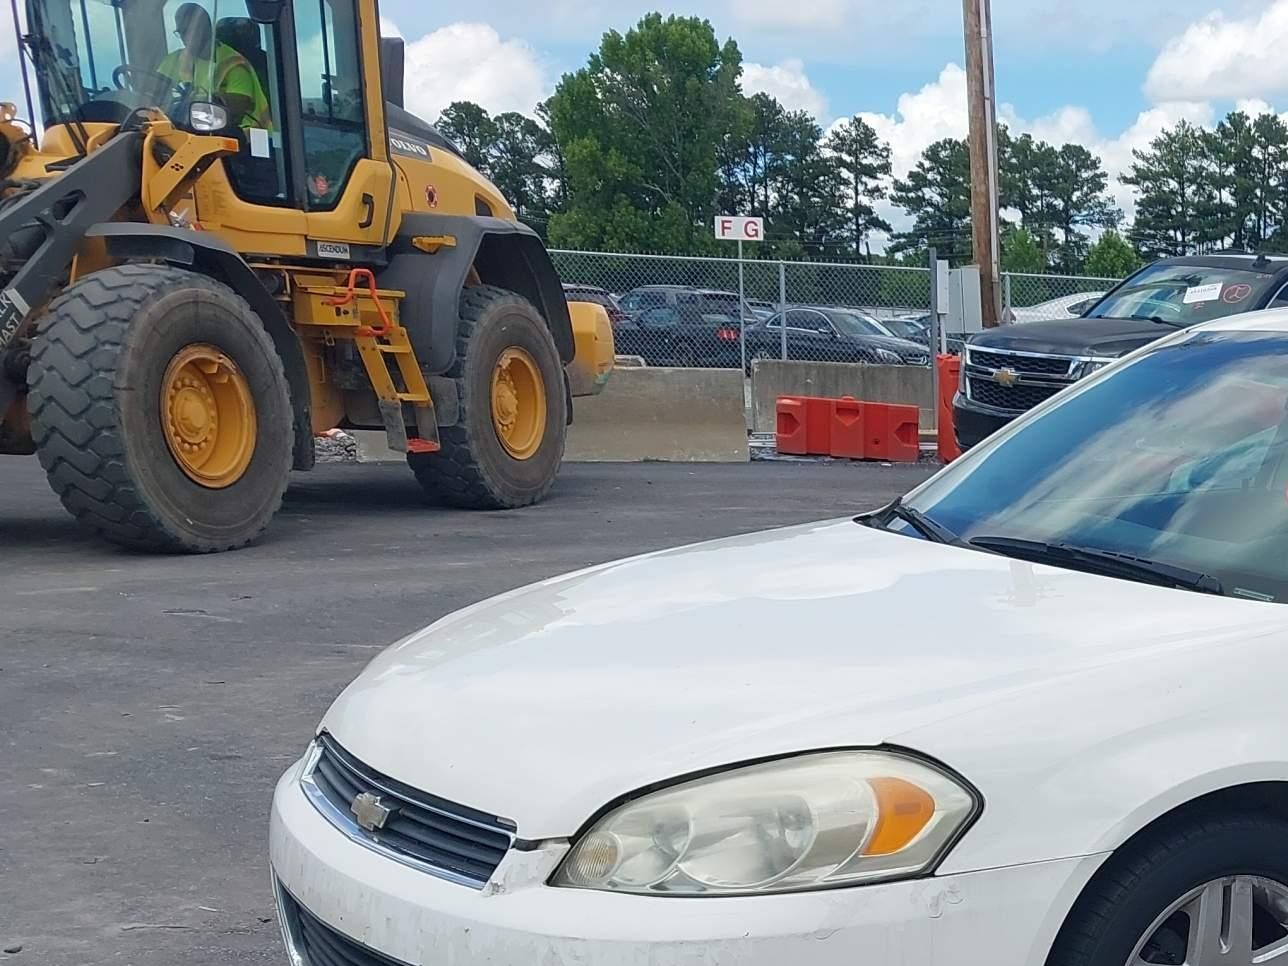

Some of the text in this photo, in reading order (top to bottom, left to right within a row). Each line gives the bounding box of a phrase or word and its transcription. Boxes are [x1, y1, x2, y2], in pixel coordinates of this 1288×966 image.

[390, 138, 428, 156] OLVO
[721, 220, 758, 238] F G
